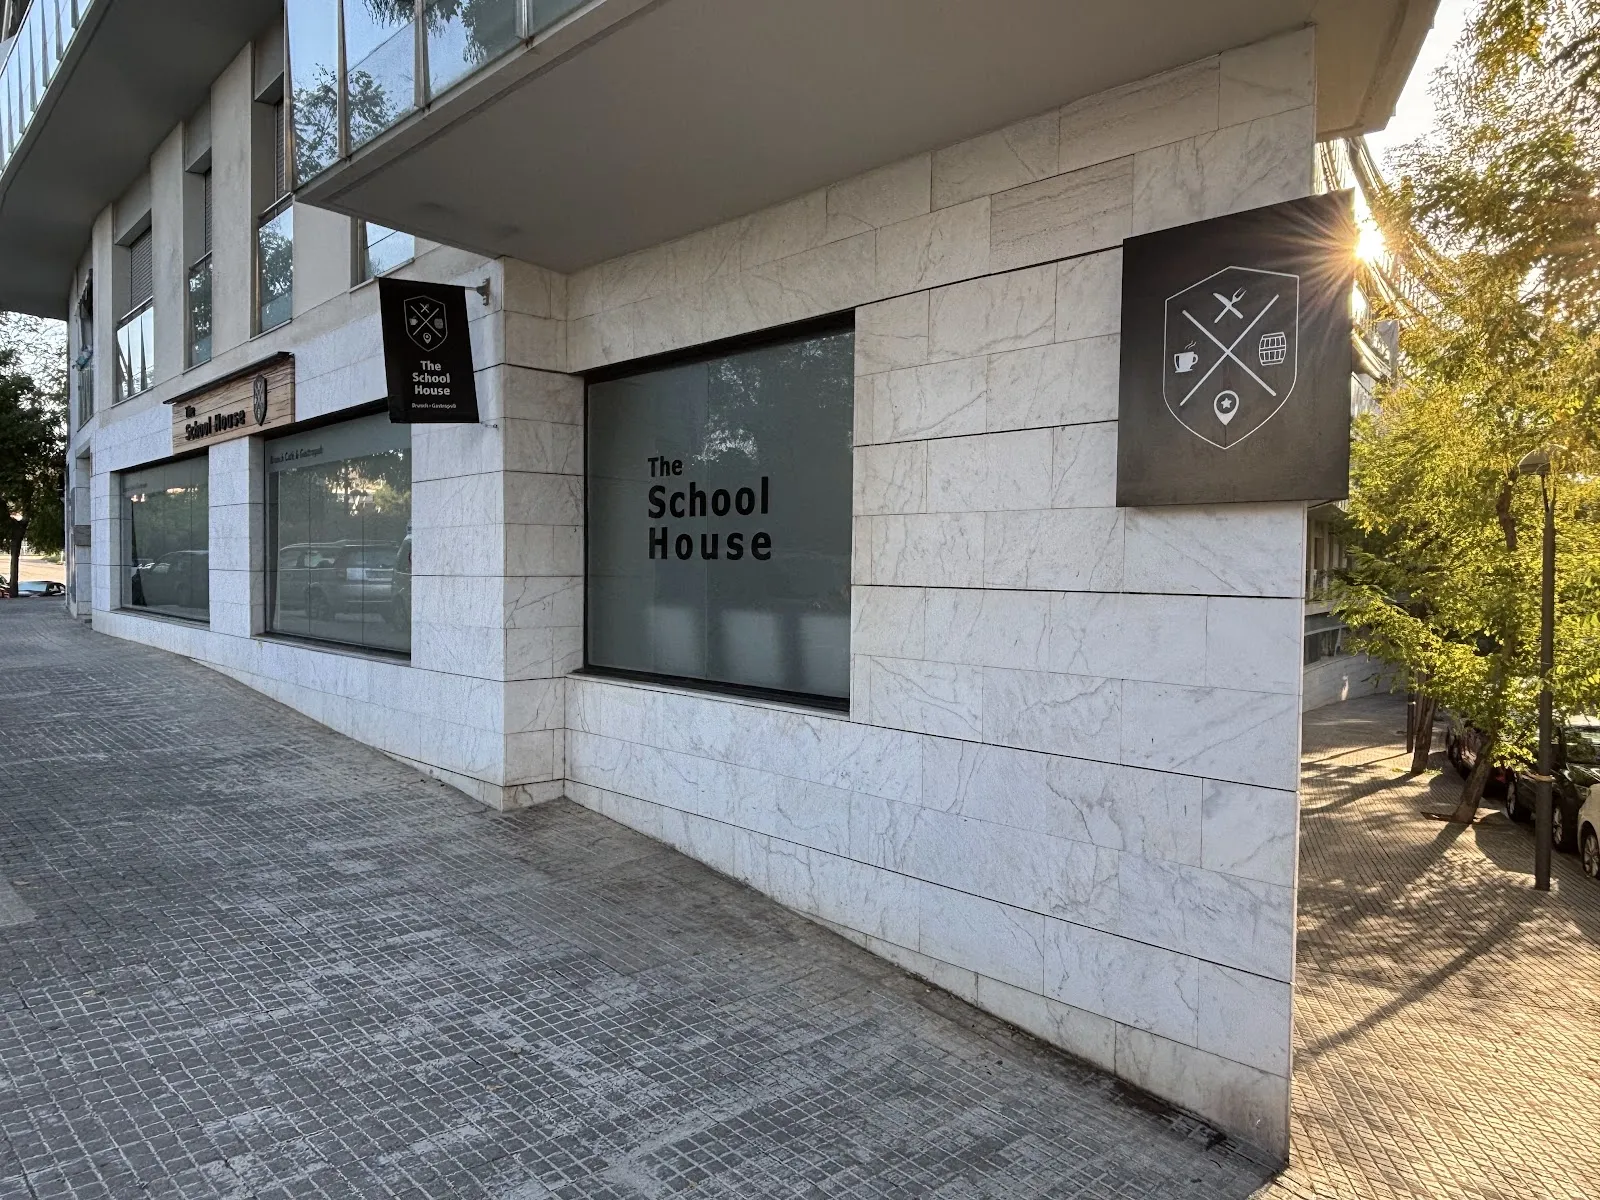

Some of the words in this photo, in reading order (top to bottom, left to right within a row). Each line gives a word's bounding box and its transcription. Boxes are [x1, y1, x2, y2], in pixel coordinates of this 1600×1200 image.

[420, 360, 442, 371] The
[412, 372, 451, 384] School
[414, 384, 451, 396] House
[185, 405, 196, 418] The
[185, 416, 212, 441] School
[214, 409, 246, 433] House
[647, 455, 683, 477] The
[648, 476, 769, 519] School
[649, 526, 772, 561] House
